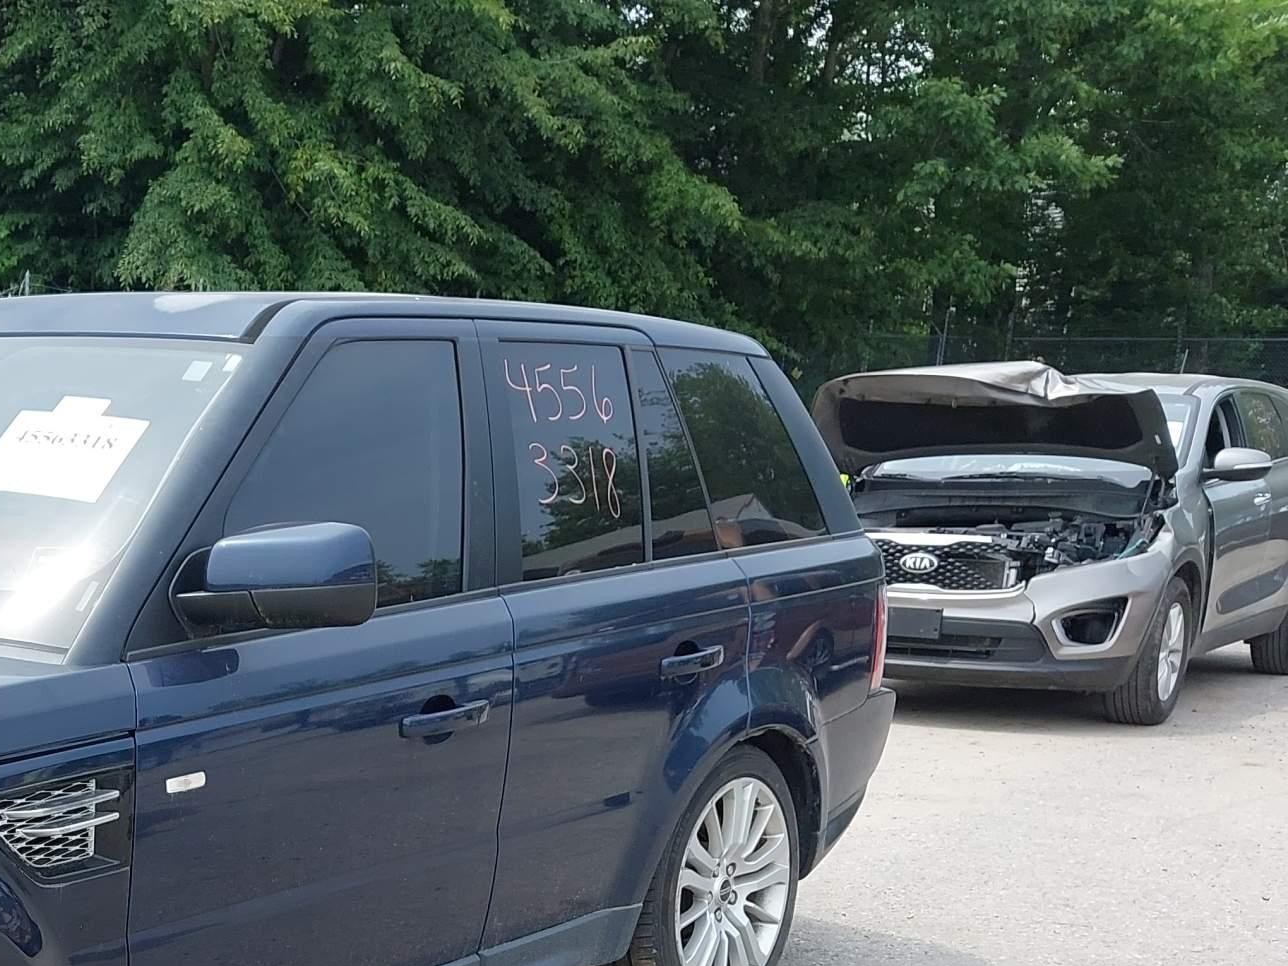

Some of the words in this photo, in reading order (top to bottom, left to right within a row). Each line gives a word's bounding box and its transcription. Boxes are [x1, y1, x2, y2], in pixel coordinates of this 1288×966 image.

[504, 358, 614, 425] 4556
[528, 442, 622, 519] 3318
[905, 556, 931, 570] KIA
